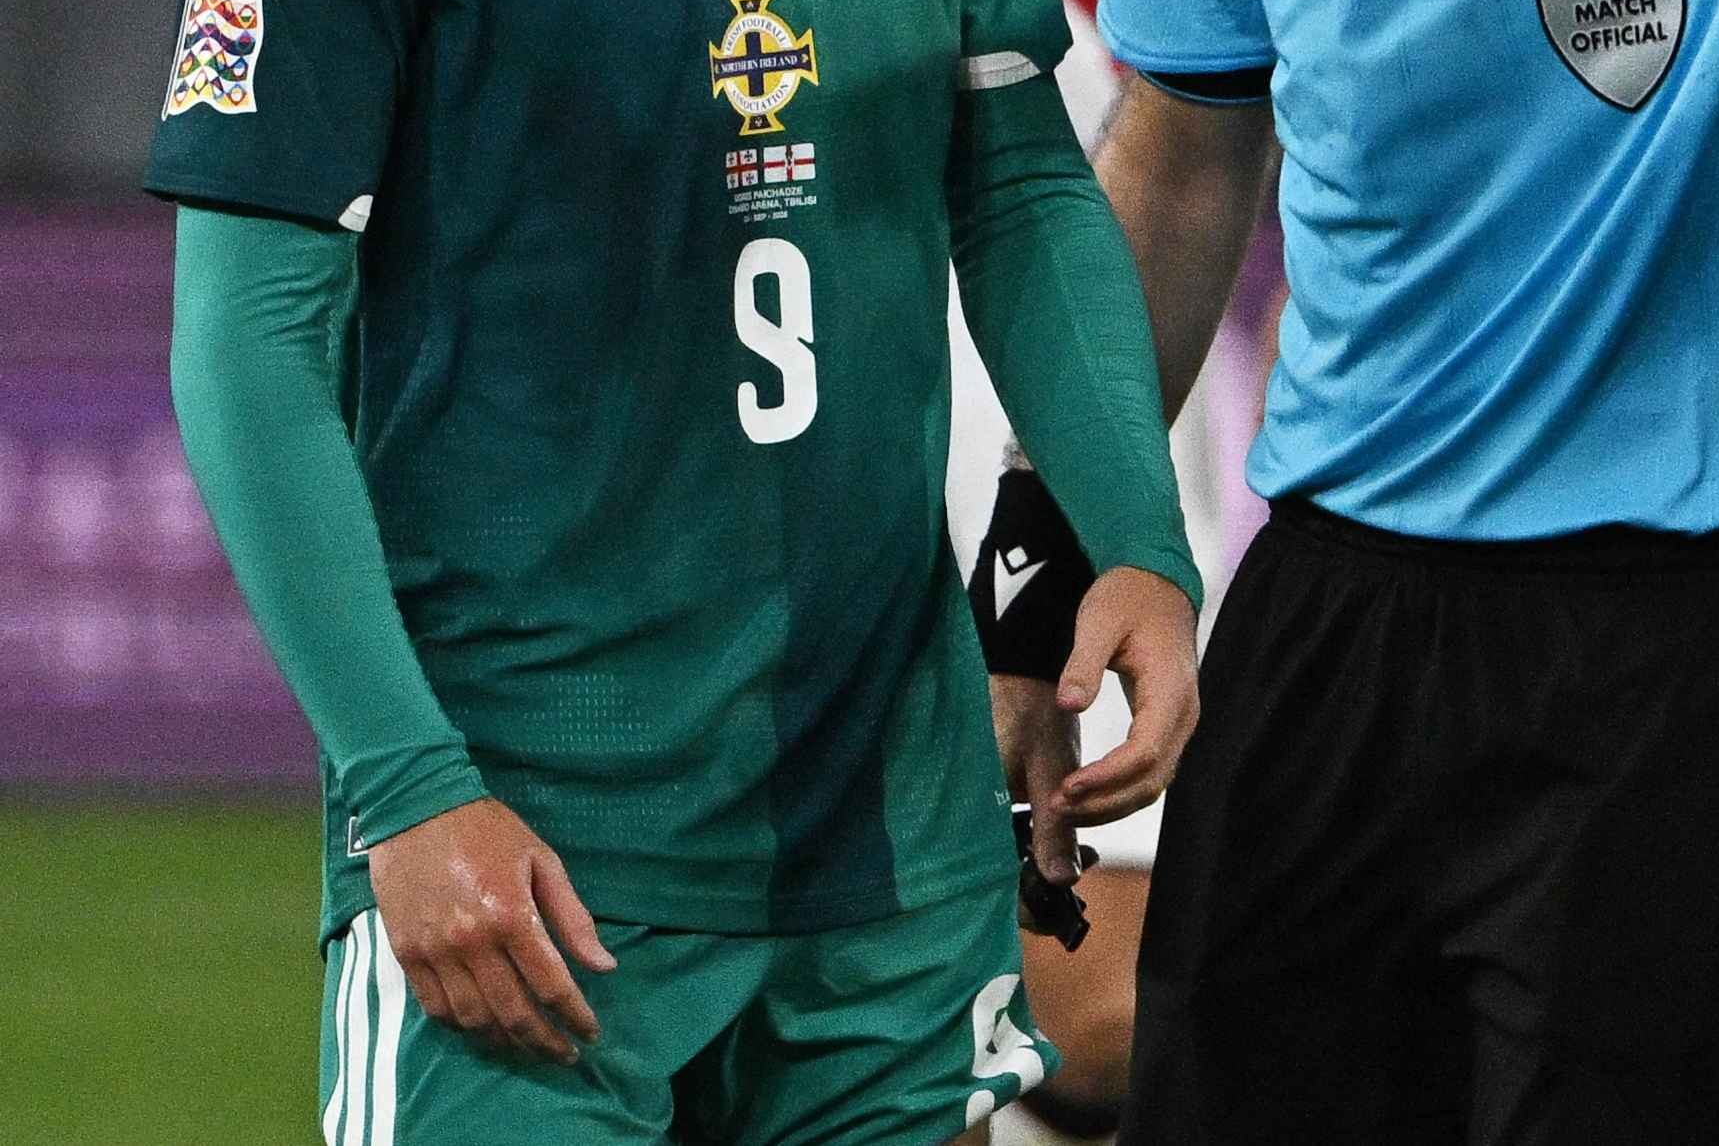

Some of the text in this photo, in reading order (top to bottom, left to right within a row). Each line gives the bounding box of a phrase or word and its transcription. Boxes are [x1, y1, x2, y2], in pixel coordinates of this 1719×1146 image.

[742, 17, 788, 42] FOOTBALL
[1570, 21, 1669, 54] OFFICIAL
[759, 56, 798, 69] IRELAND
[731, 83, 790, 111] ASSOCIATION
[733, 237, 818, 444] 9
